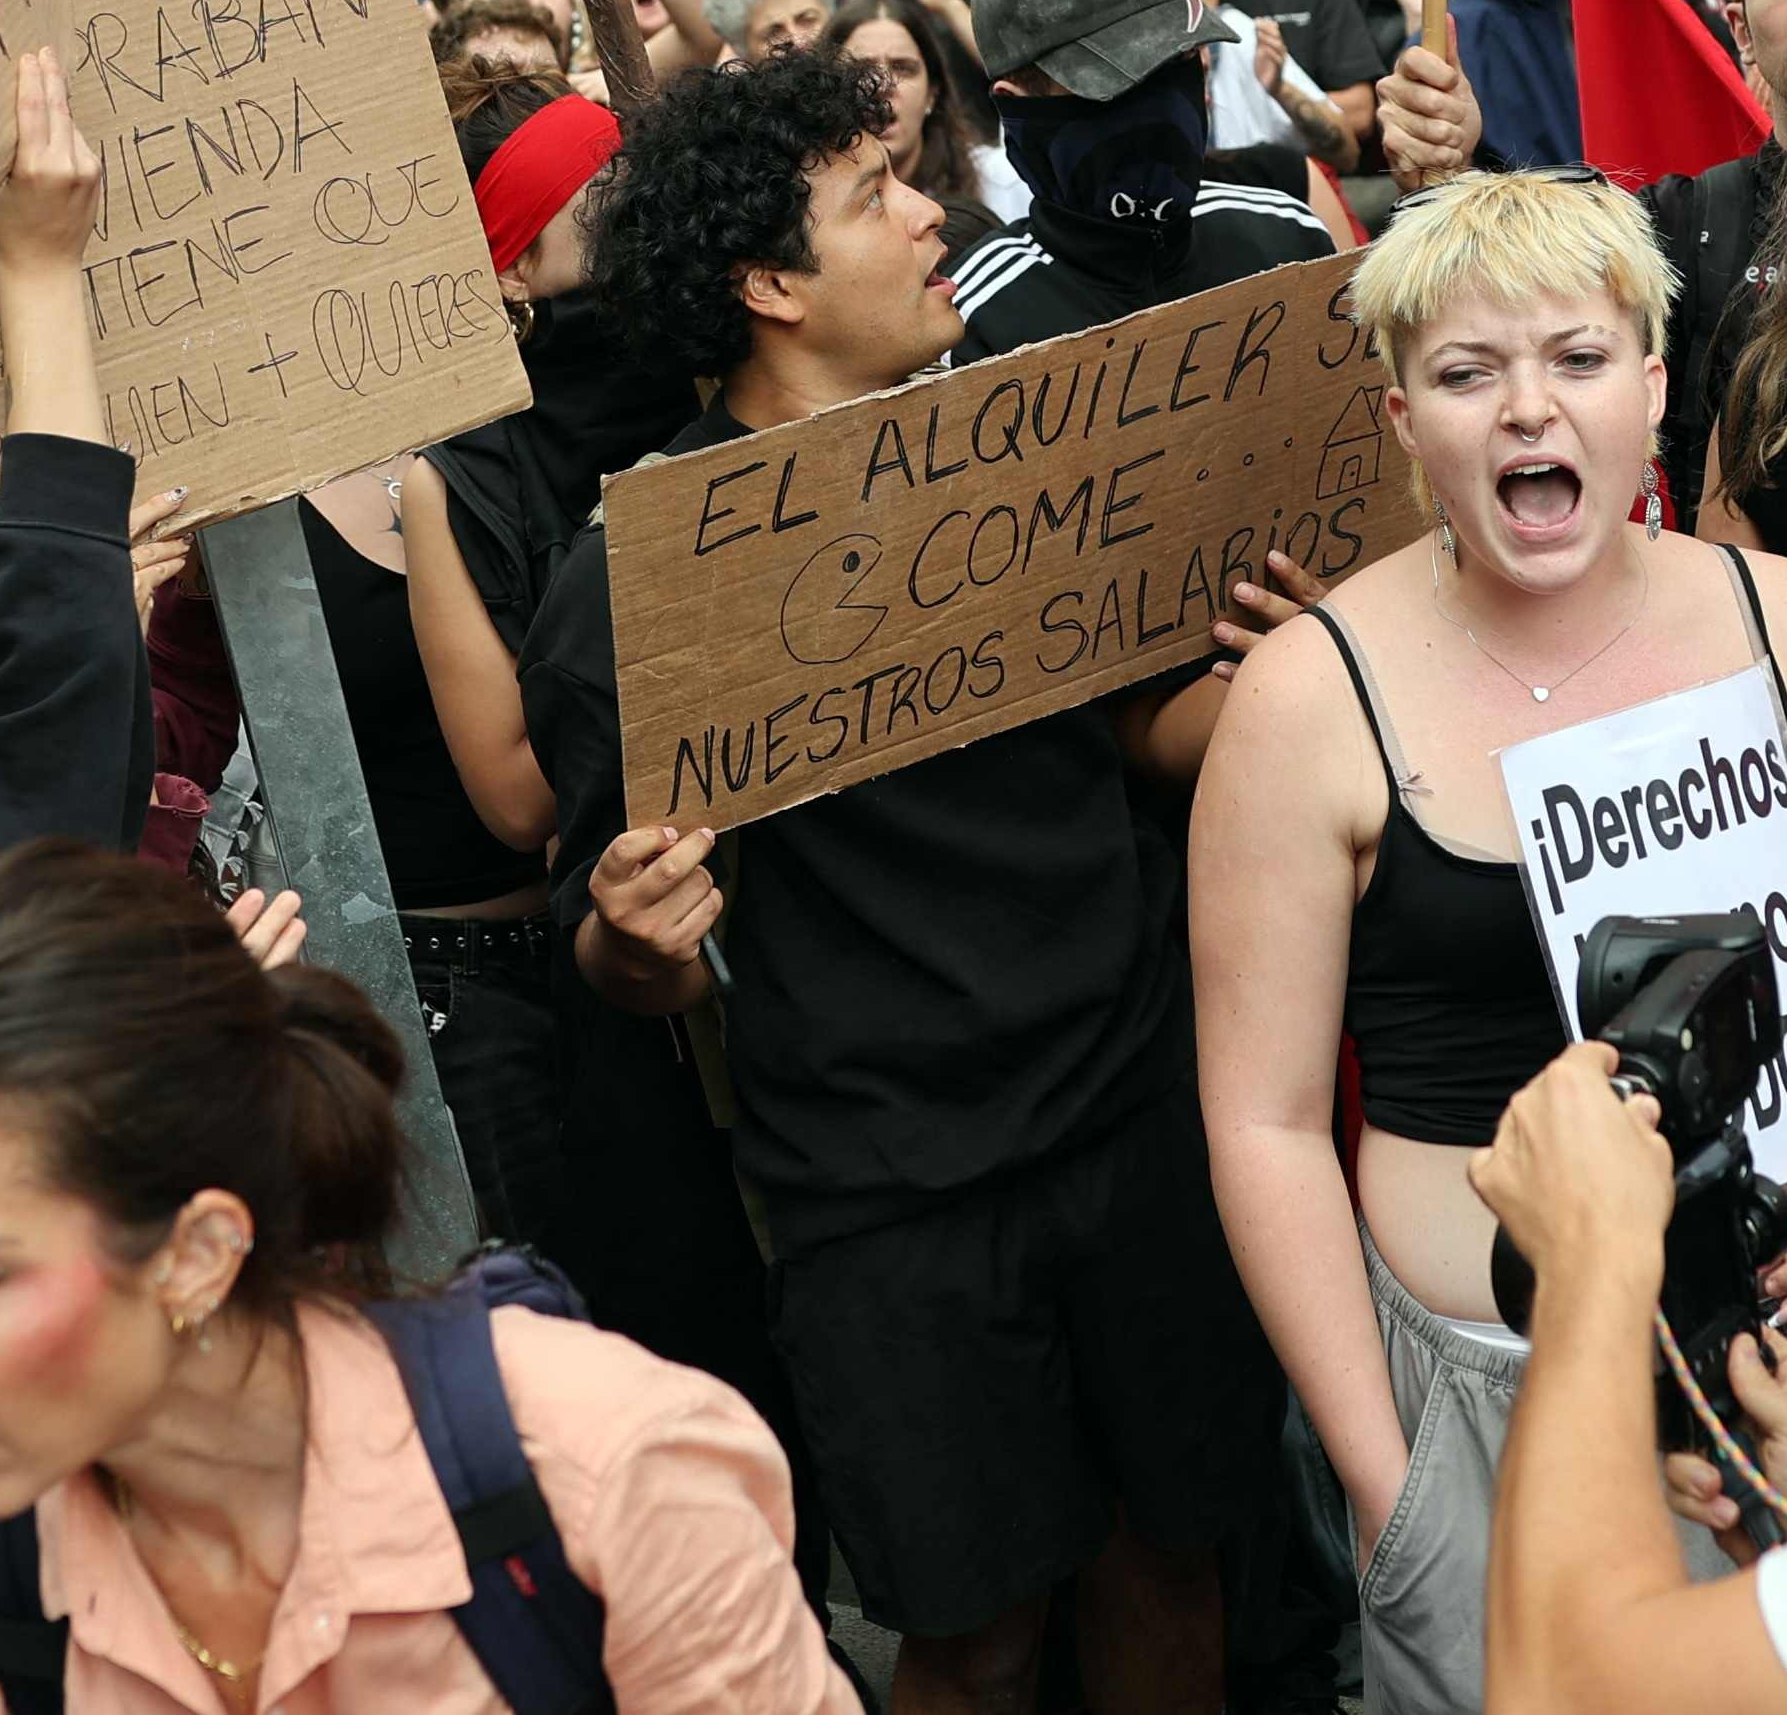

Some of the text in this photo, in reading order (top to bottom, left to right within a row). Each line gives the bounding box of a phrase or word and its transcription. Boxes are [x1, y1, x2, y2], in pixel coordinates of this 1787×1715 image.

[312, 154, 461, 247] QUE
[695, 451, 819, 556] EL
[907, 449, 1167, 609] COME
[665, 629, 1008, 817] NUESTROS
